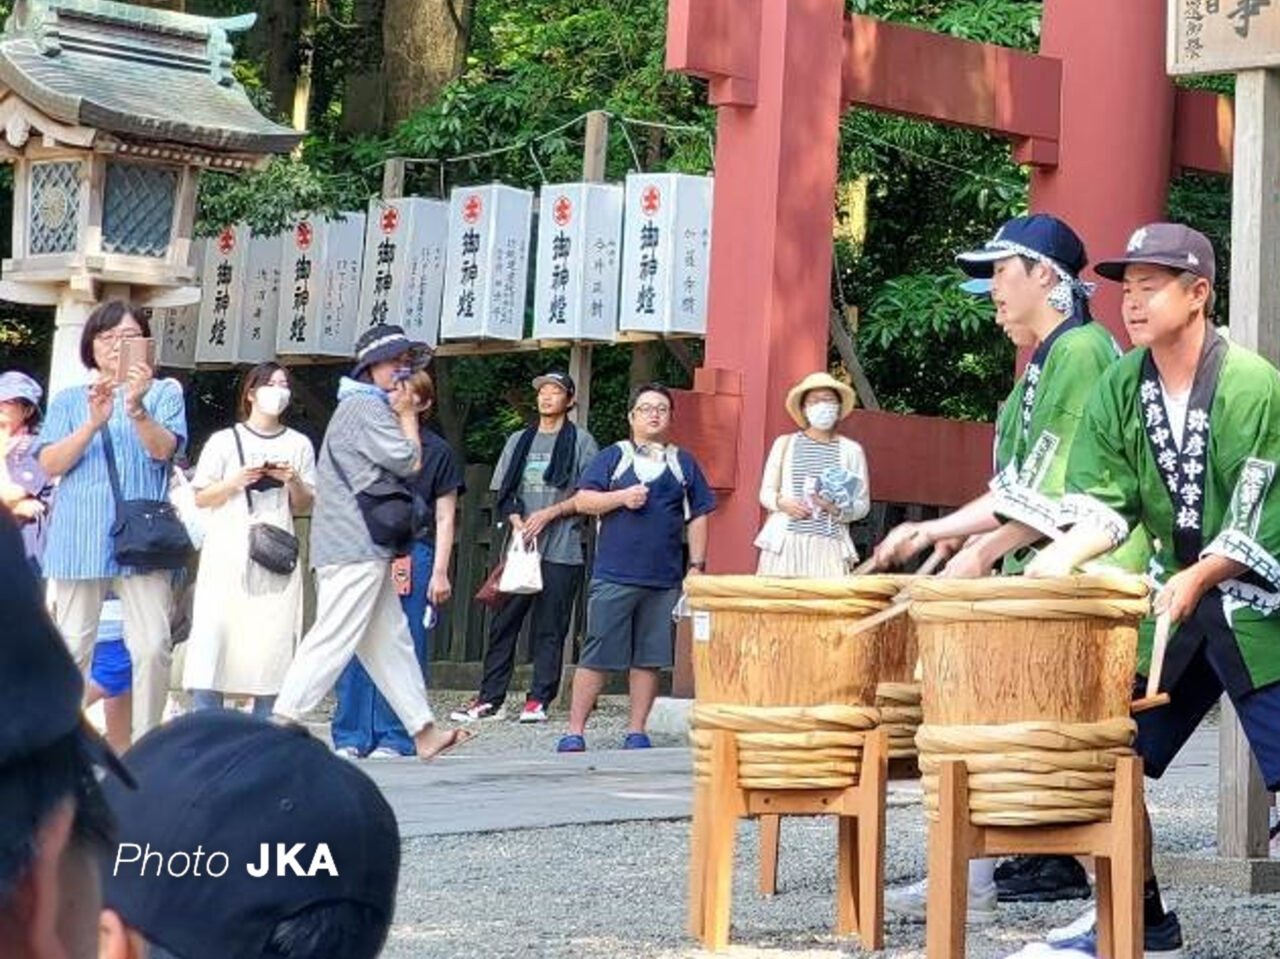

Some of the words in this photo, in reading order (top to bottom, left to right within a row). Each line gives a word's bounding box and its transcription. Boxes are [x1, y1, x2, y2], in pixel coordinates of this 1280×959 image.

[209, 259, 232, 346] 御神燈
[289, 253, 311, 342] 御神燈
[456, 227, 480, 318] 御神燈
[548, 230, 572, 324] 御神燈
[636, 220, 659, 314] 御神燈
[1177, 408, 1209, 529] 弥彦中学校
